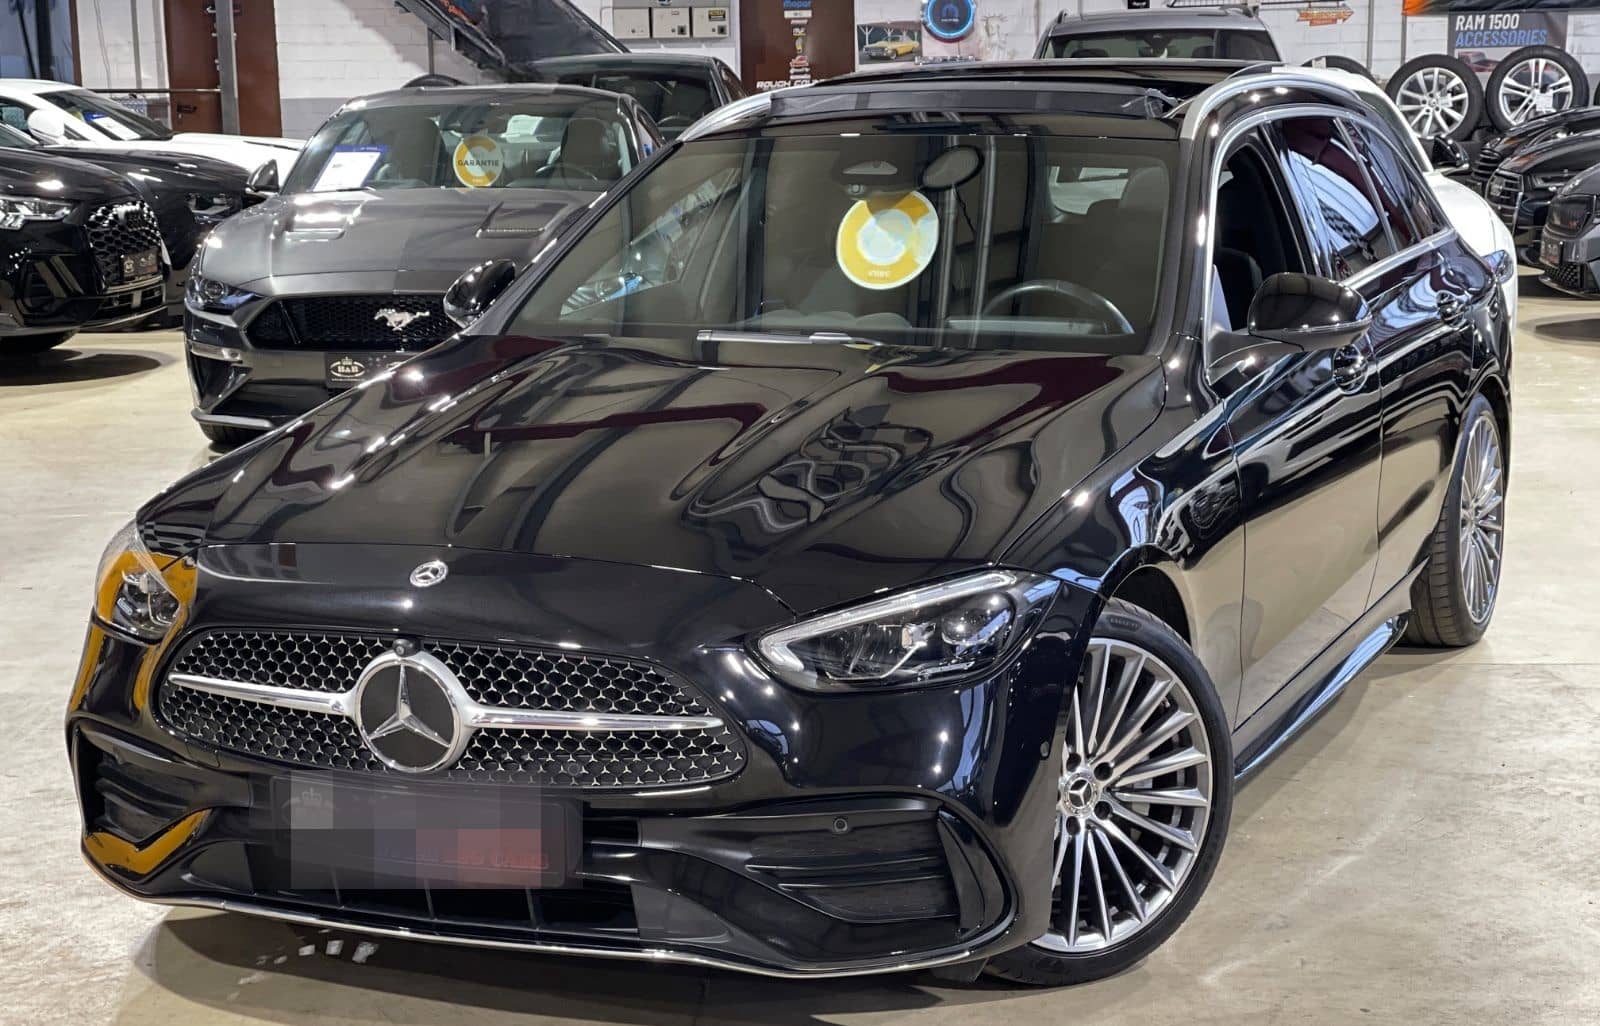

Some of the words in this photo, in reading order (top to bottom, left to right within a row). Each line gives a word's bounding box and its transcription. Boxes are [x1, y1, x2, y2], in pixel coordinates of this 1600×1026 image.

[1456, 15, 1486, 31] RAM
[1489, 13, 1520, 30] 1500
[1456, 29, 1547, 47] ACCESSORIES
[756, 81, 791, 89] ROUGH
